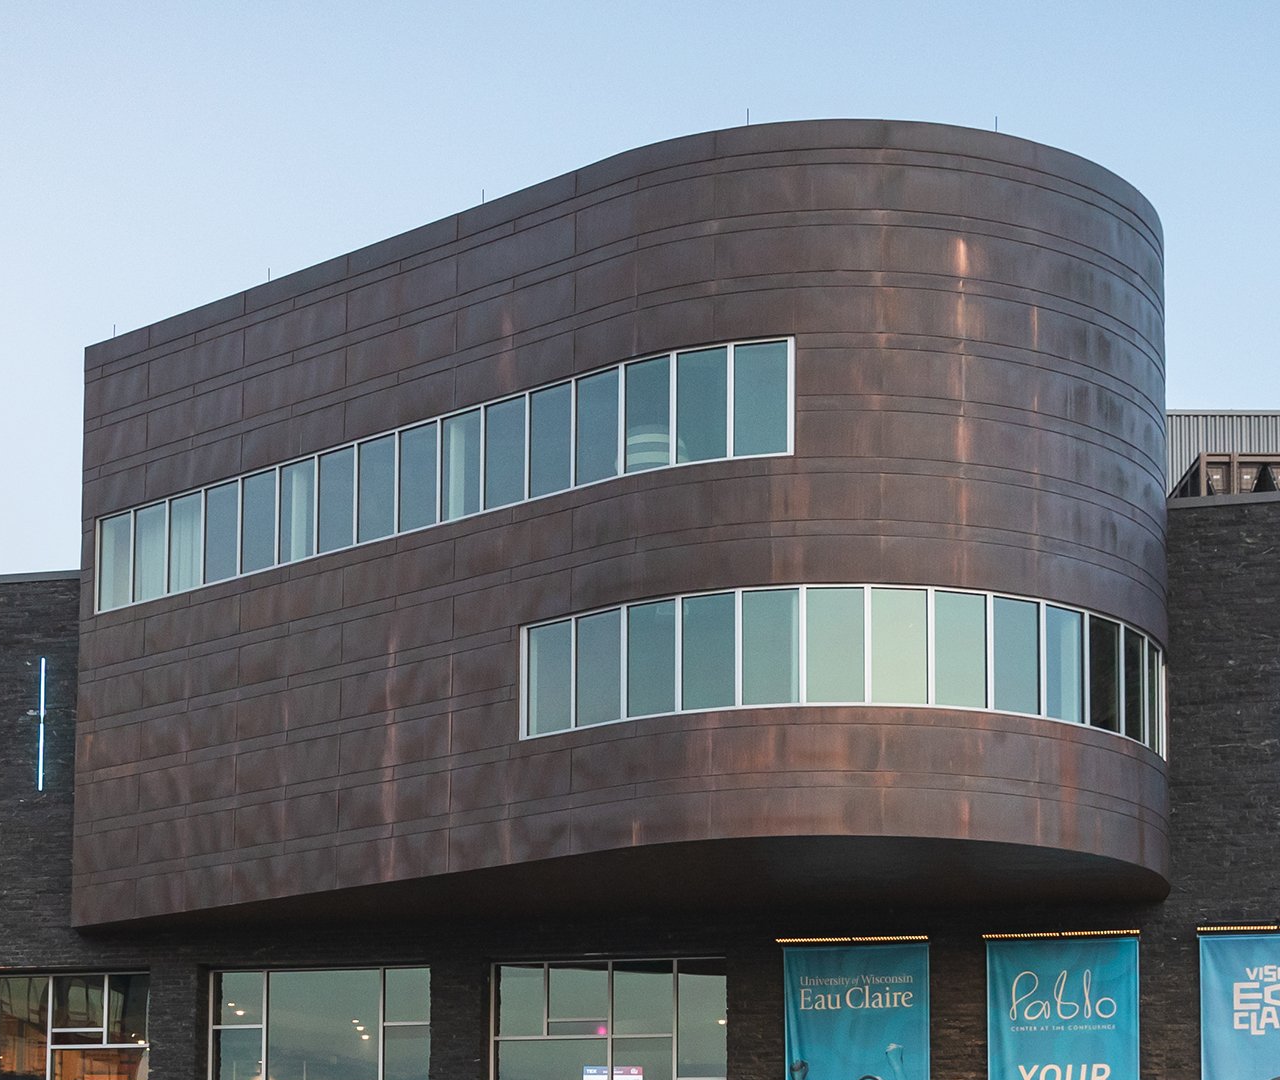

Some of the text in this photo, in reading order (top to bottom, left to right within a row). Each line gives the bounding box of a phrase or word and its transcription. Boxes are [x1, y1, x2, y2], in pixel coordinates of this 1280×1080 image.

[800, 974, 913, 987] University of Wisconsin
[800, 985, 913, 1010] Eau Claire
[1010, 969, 1117, 1021] Pablo
